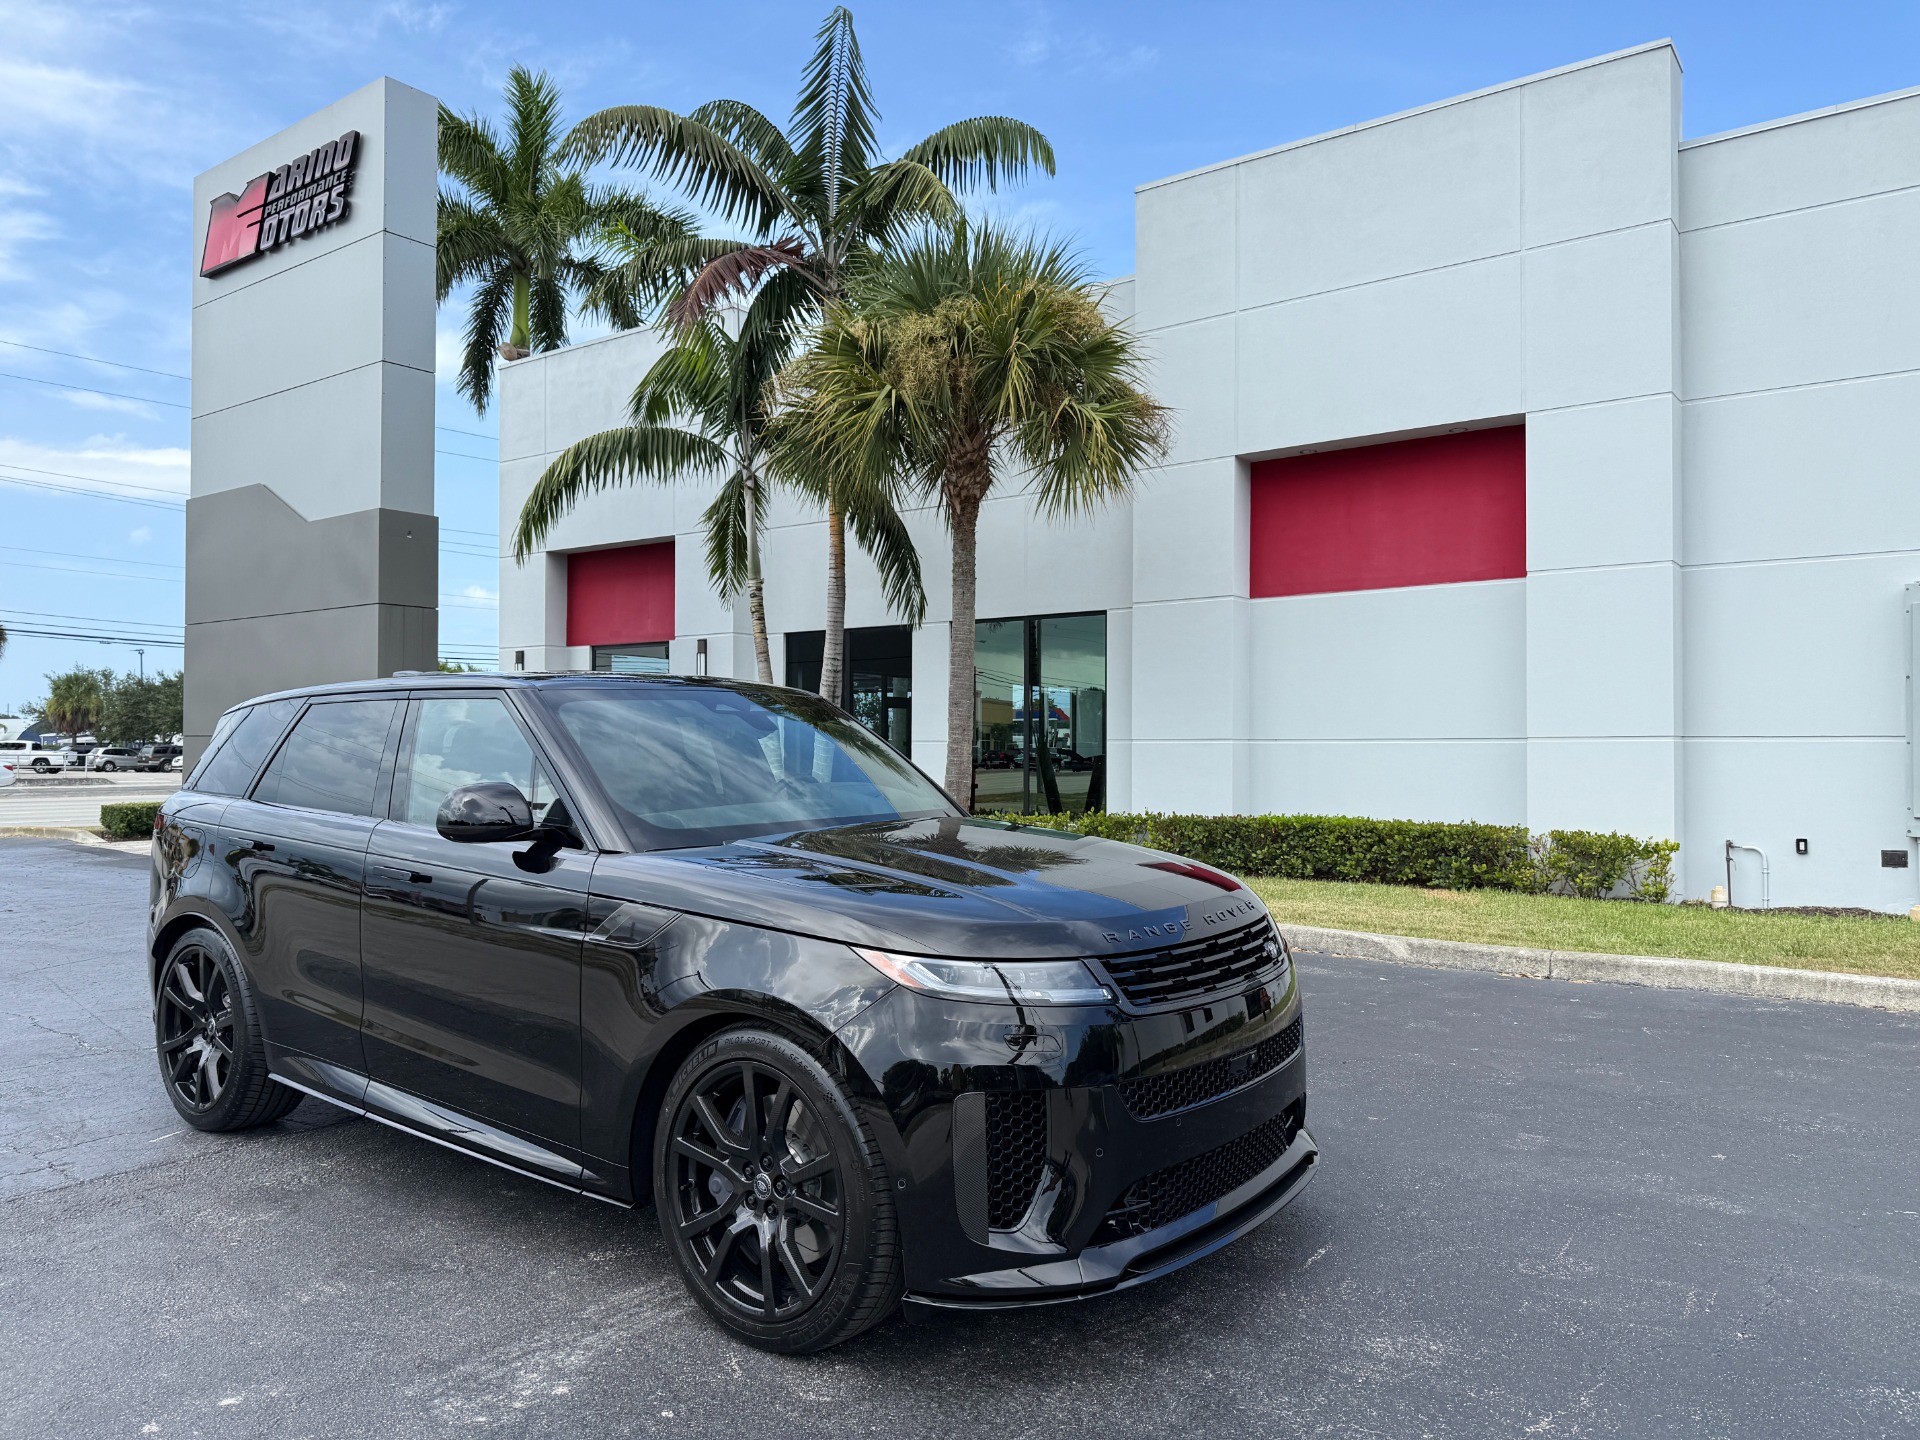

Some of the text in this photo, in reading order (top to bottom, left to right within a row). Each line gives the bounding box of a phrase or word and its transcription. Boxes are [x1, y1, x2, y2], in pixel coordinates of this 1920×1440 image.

[1102, 900, 1256, 944] RANGE ROVER
[724, 1036, 819, 1082] PILOT SPORT ALL SEASON
